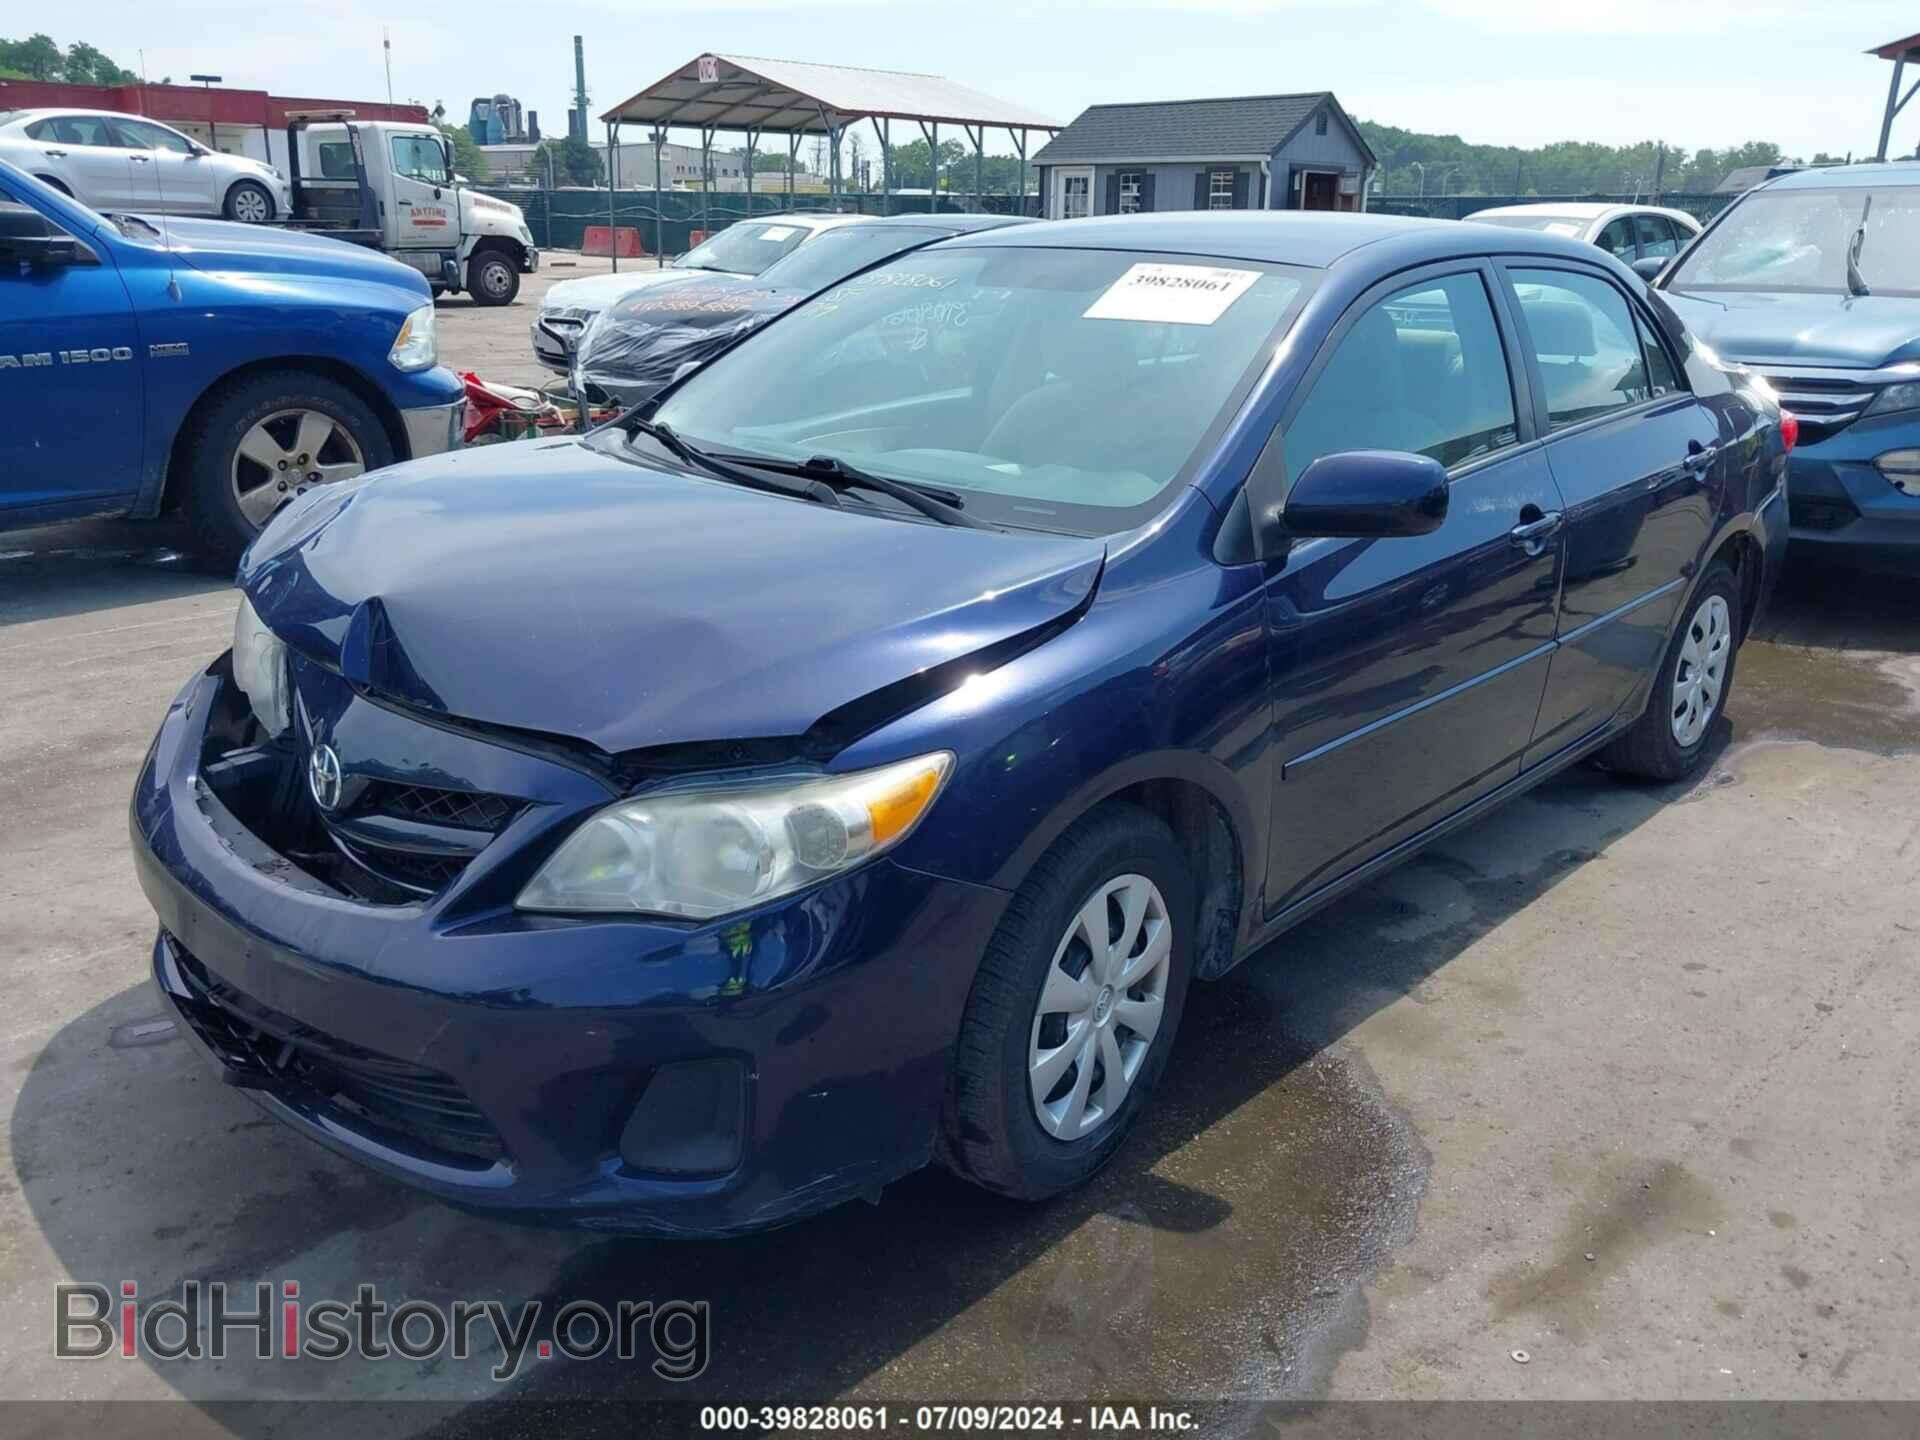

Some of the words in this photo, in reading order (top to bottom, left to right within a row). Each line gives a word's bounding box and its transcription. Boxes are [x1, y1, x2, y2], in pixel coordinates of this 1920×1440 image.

[1128, 274, 1232, 292] 39828061
[0, 352, 53, 369] AM
[59, 346, 133, 364] 1500
